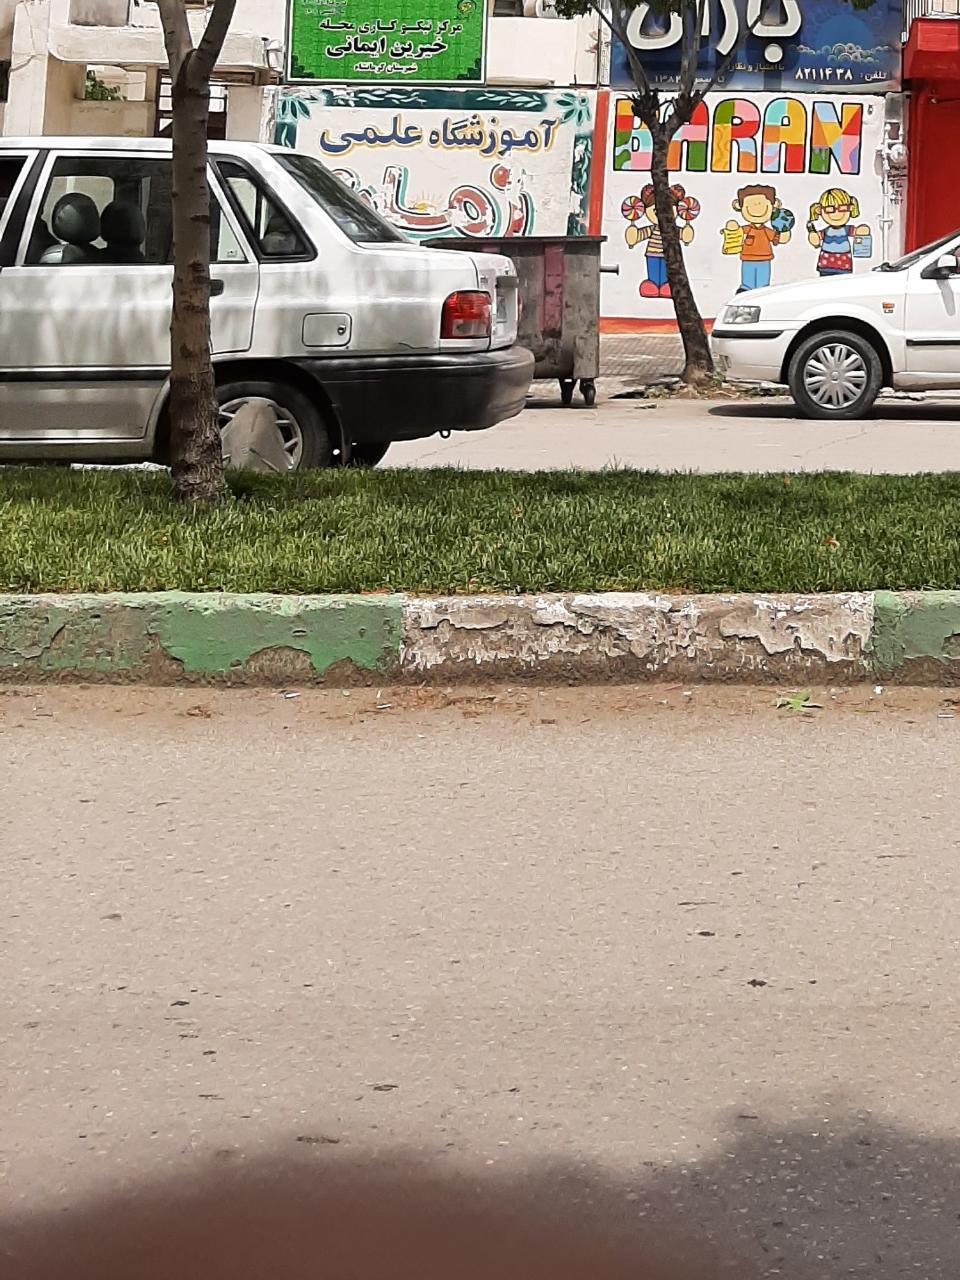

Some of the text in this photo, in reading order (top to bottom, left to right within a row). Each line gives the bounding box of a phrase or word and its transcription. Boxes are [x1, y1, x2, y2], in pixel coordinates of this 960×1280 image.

[319, 18, 463, 35] مرکز نیکو کاری محله
[326, 34, 447, 58] خیرین ایمانی
[320, 113, 561, 155] آموزشگاه علمی
[612, 96, 864, 175] BARAN
